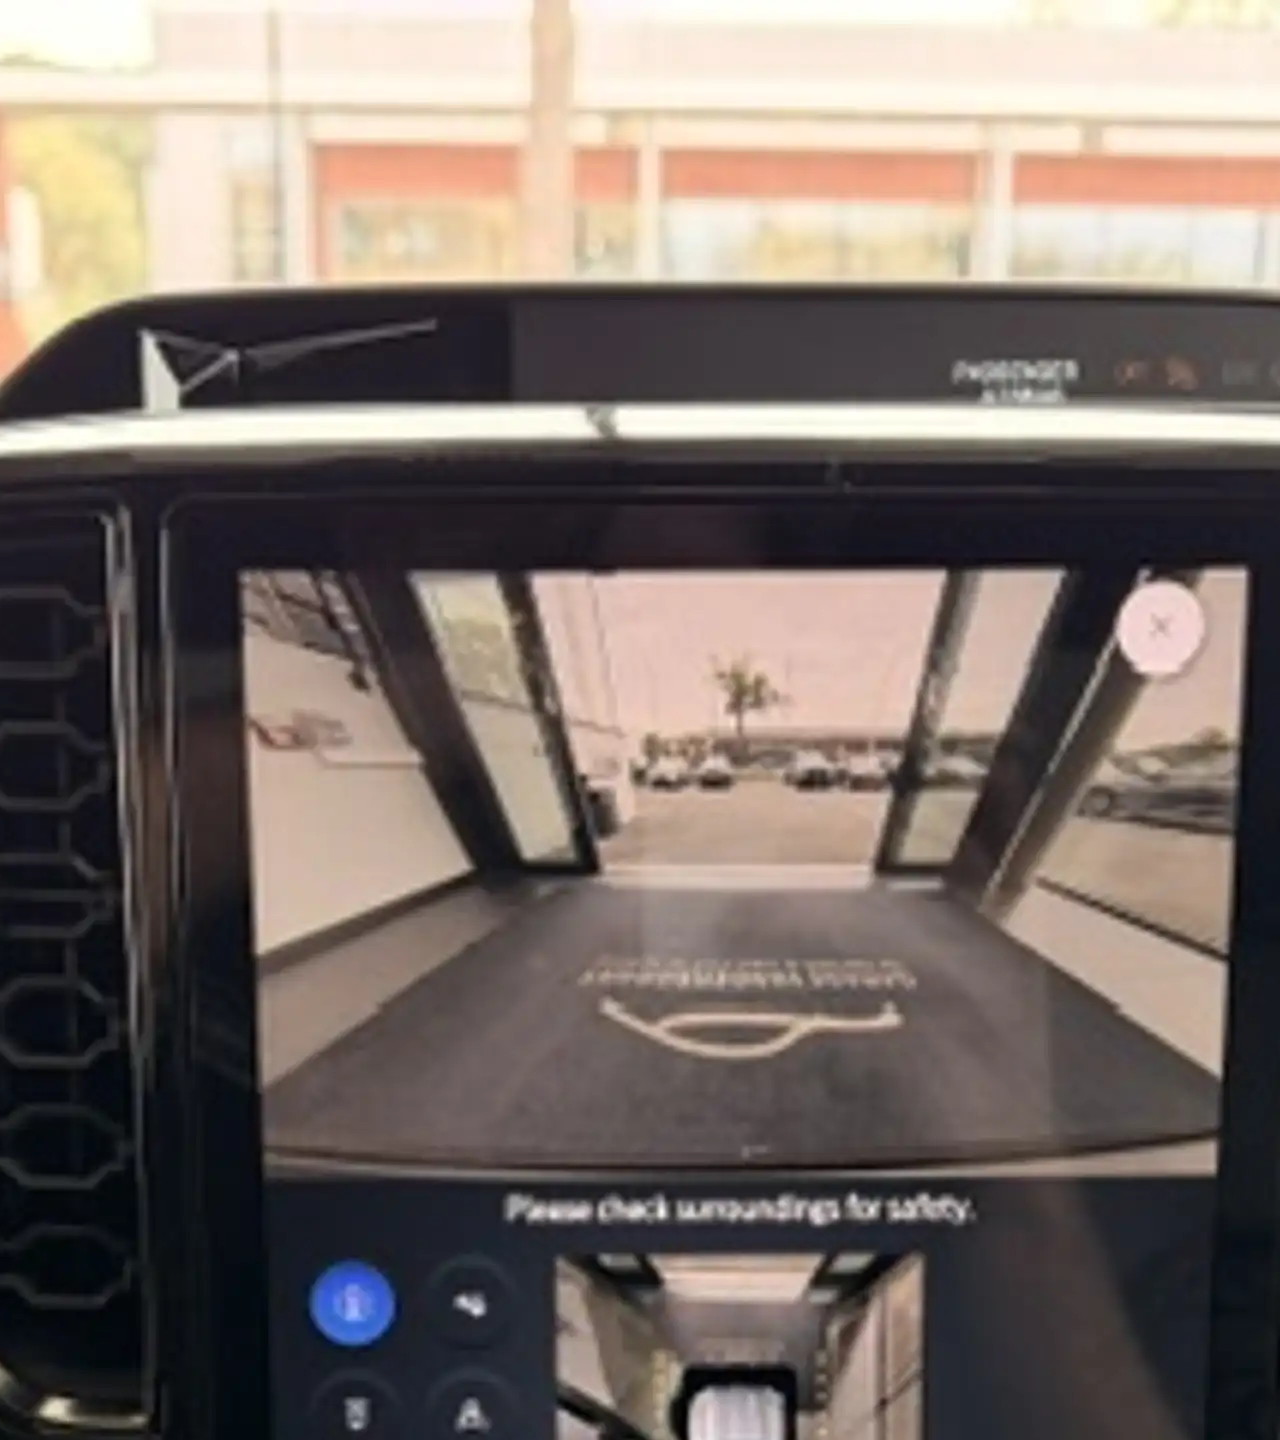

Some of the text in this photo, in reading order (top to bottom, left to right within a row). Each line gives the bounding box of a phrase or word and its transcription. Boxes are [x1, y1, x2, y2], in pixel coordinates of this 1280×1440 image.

[504, 1191, 976, 1226] Please check surroundings for safety.
